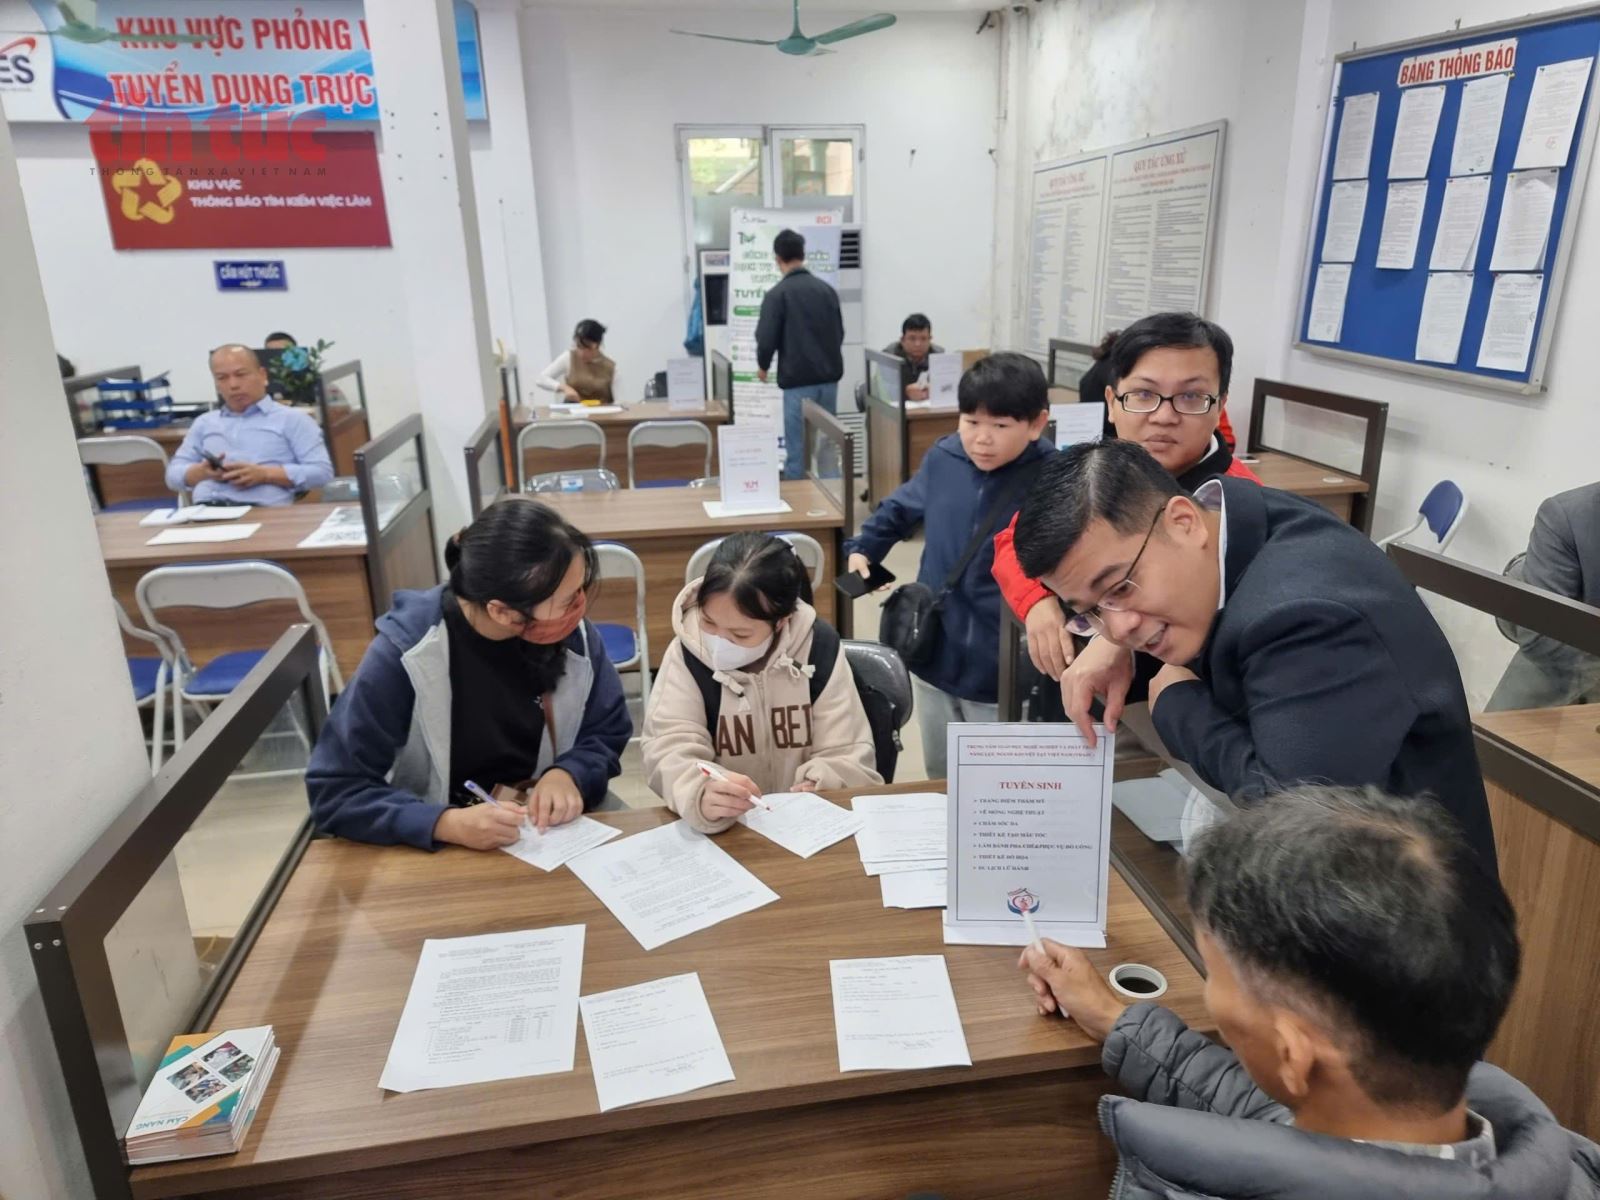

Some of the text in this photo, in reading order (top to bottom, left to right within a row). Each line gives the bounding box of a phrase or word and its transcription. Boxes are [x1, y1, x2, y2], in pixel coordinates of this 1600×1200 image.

[252, 7, 353, 50] PHỎNG
[1485, 43, 1514, 72] BÁO
[109, 61, 374, 112] TUYỂN DỤNG TRỰC
[187, 178, 242, 191] KHU VỰC
[190, 194, 233, 208] THÔNG
[234, 194, 262, 208] BÁO
[316, 193, 345, 209] VIỆC
[345, 194, 372, 208] LÀM
[1036, 779, 1062, 790] SINH
